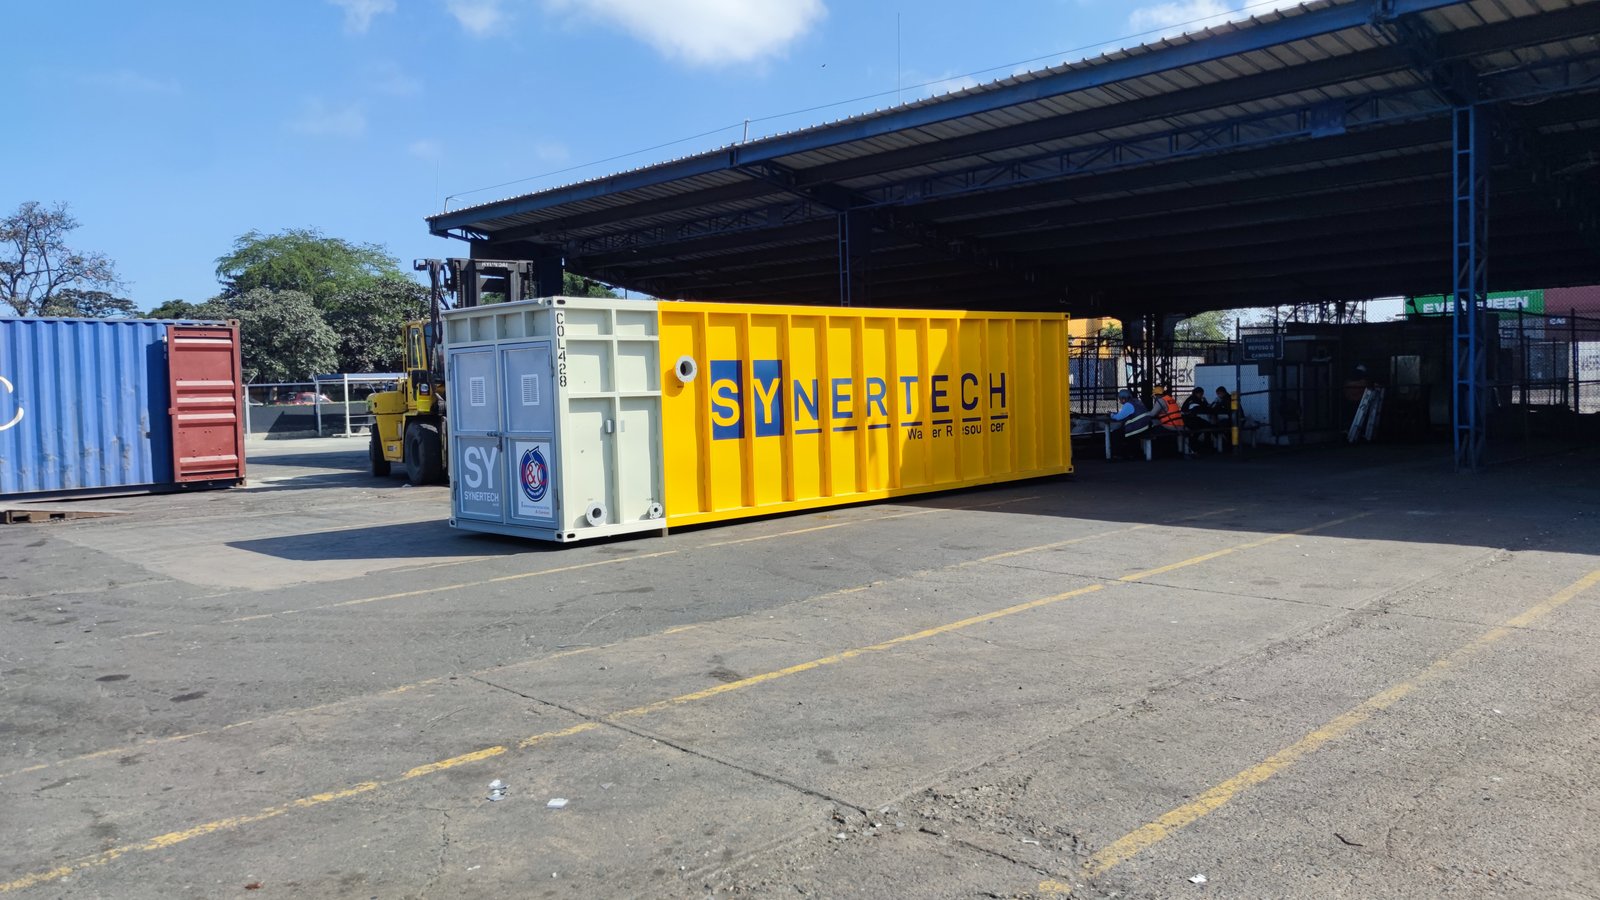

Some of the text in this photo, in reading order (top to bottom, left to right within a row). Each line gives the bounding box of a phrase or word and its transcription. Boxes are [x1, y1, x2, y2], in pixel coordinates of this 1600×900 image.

[711, 372, 1006, 427] SYNERTECH
[907, 428, 941, 440] Waer
[464, 446, 498, 489] SY
[464, 490, 499, 502] SYNERTECH
